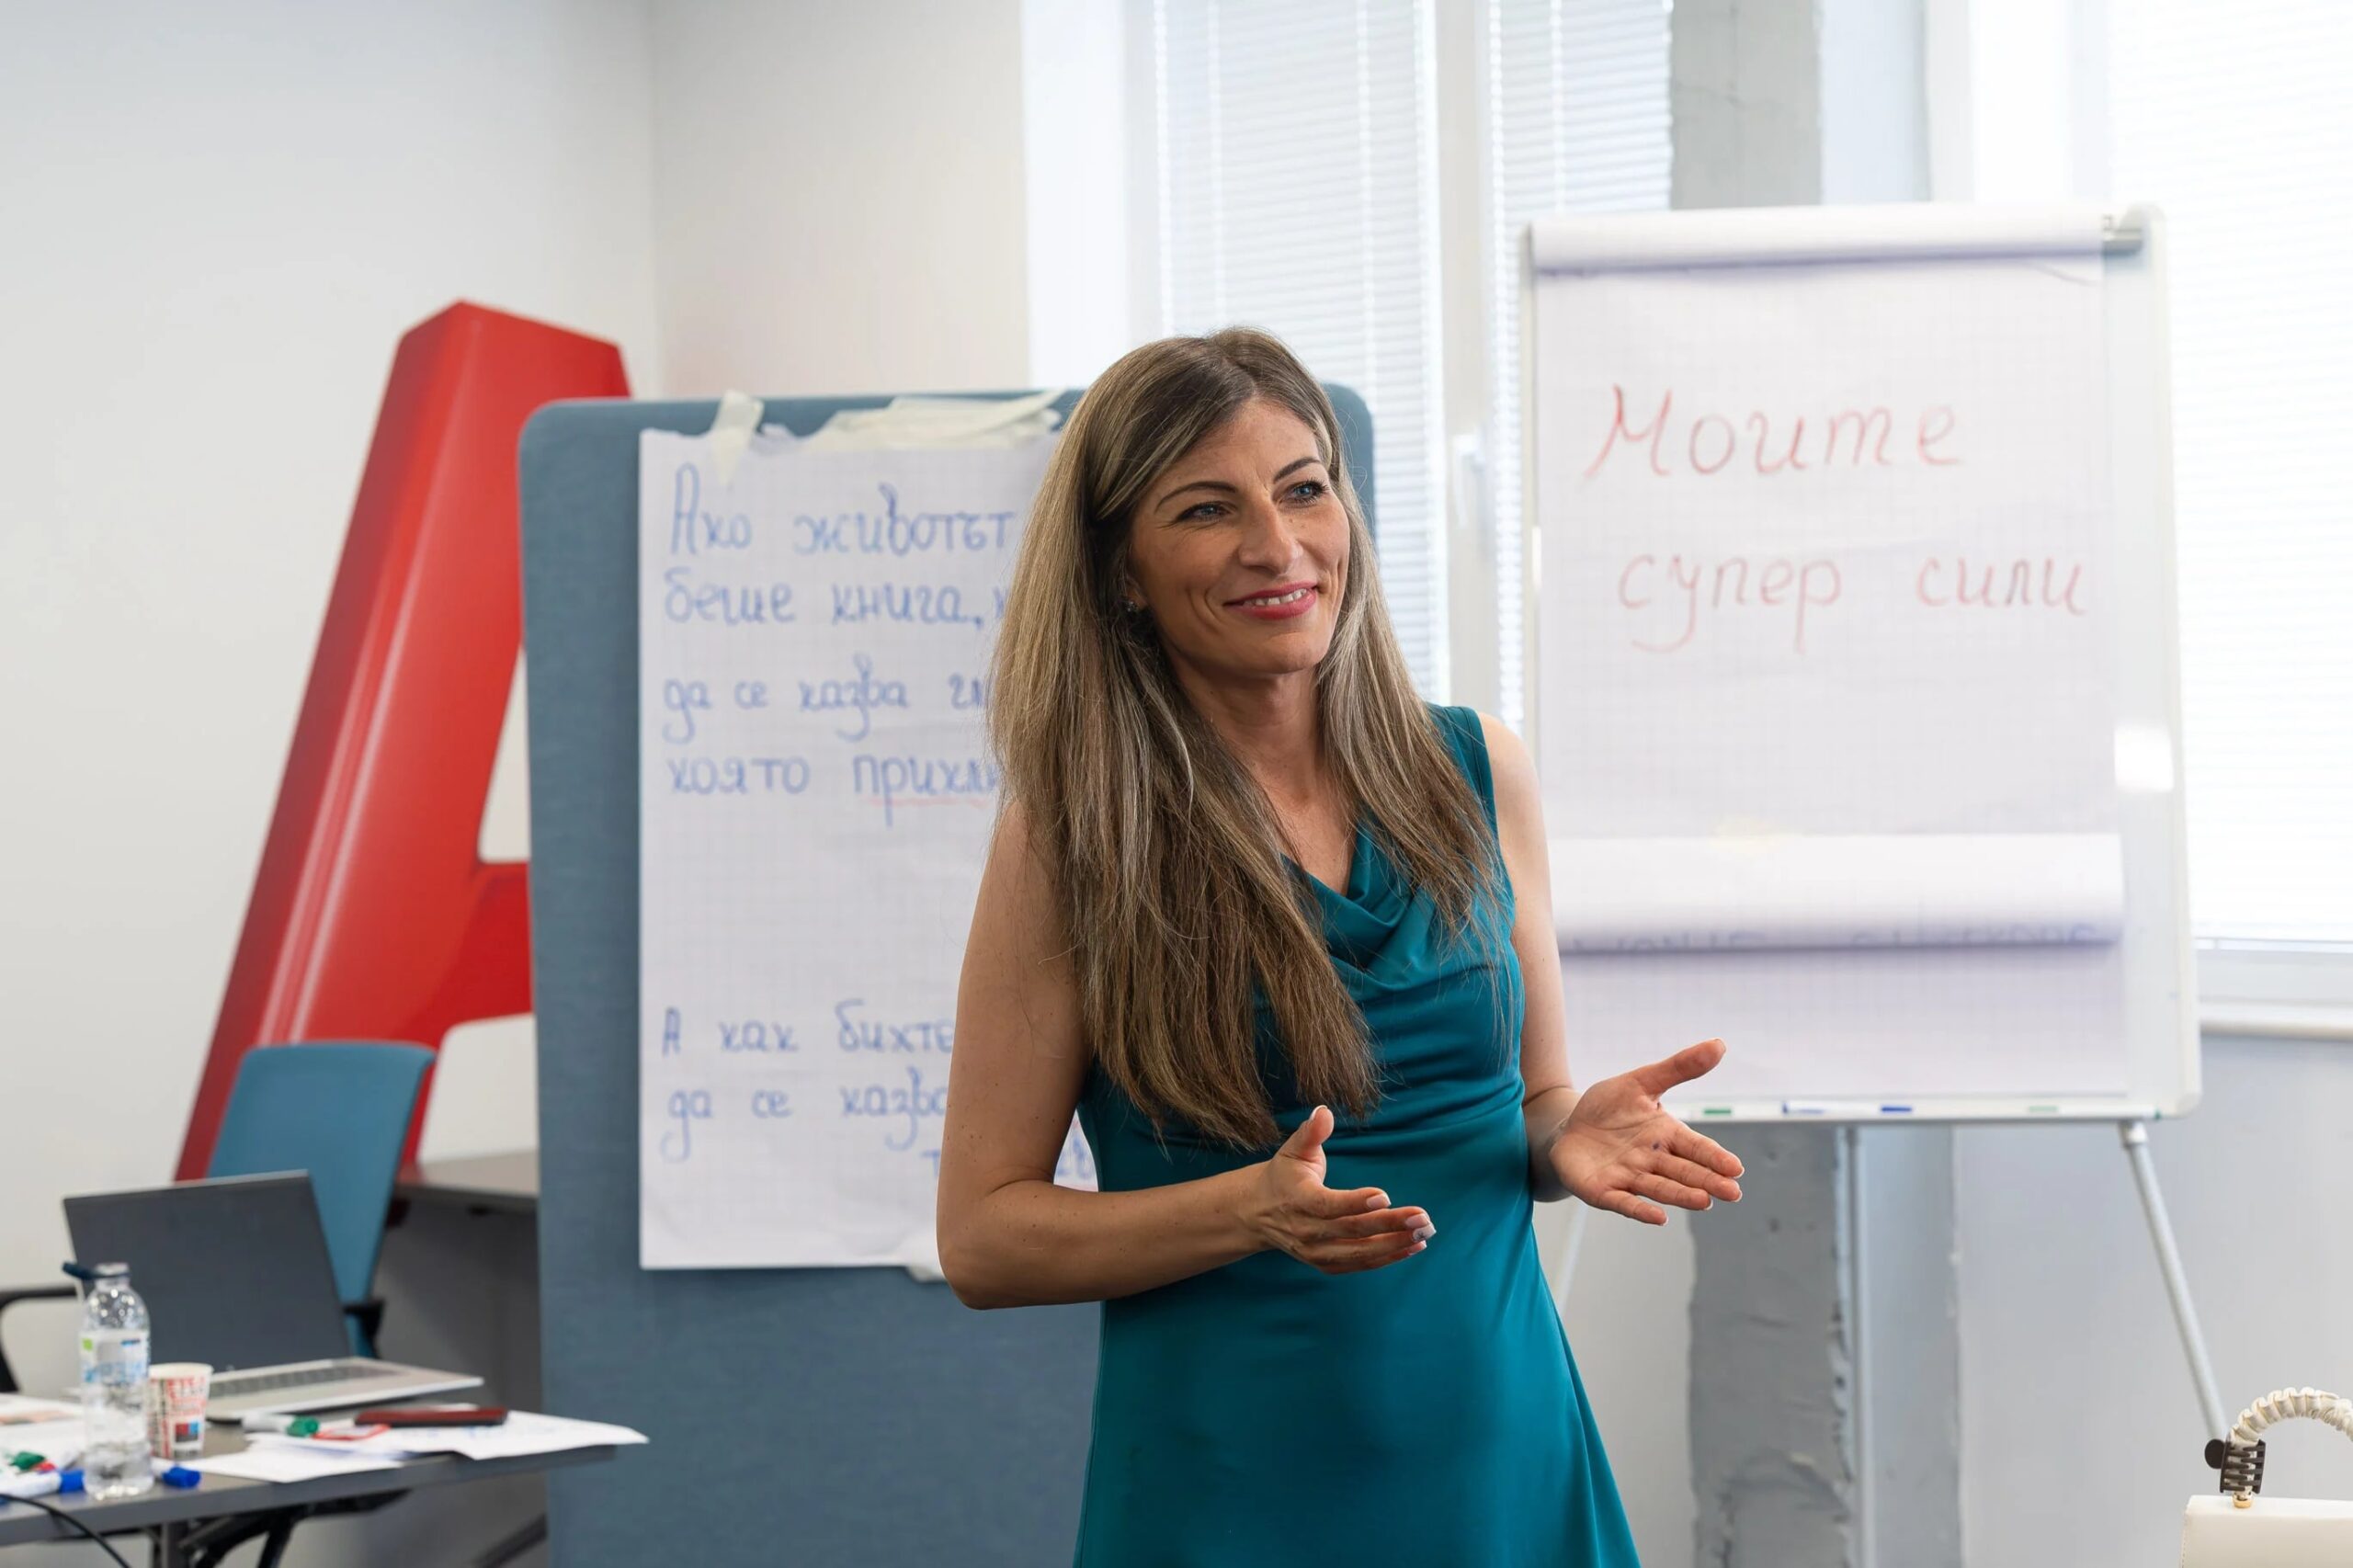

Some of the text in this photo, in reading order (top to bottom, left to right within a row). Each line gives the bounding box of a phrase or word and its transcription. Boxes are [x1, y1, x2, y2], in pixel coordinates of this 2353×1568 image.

[1582, 383, 1963, 478] Моите
[671, 461, 1016, 557] Ако животът
[663, 566, 797, 626] беше
[1619, 553, 2088, 653] супер сили
[662, 677, 713, 745] да
[735, 678, 768, 711] се
[797, 652, 910, 743] казва
[667, 754, 811, 795] която
[720, 1019, 799, 1053] как
[660, 1089, 713, 1165] да
[752, 1089, 793, 1119] се
